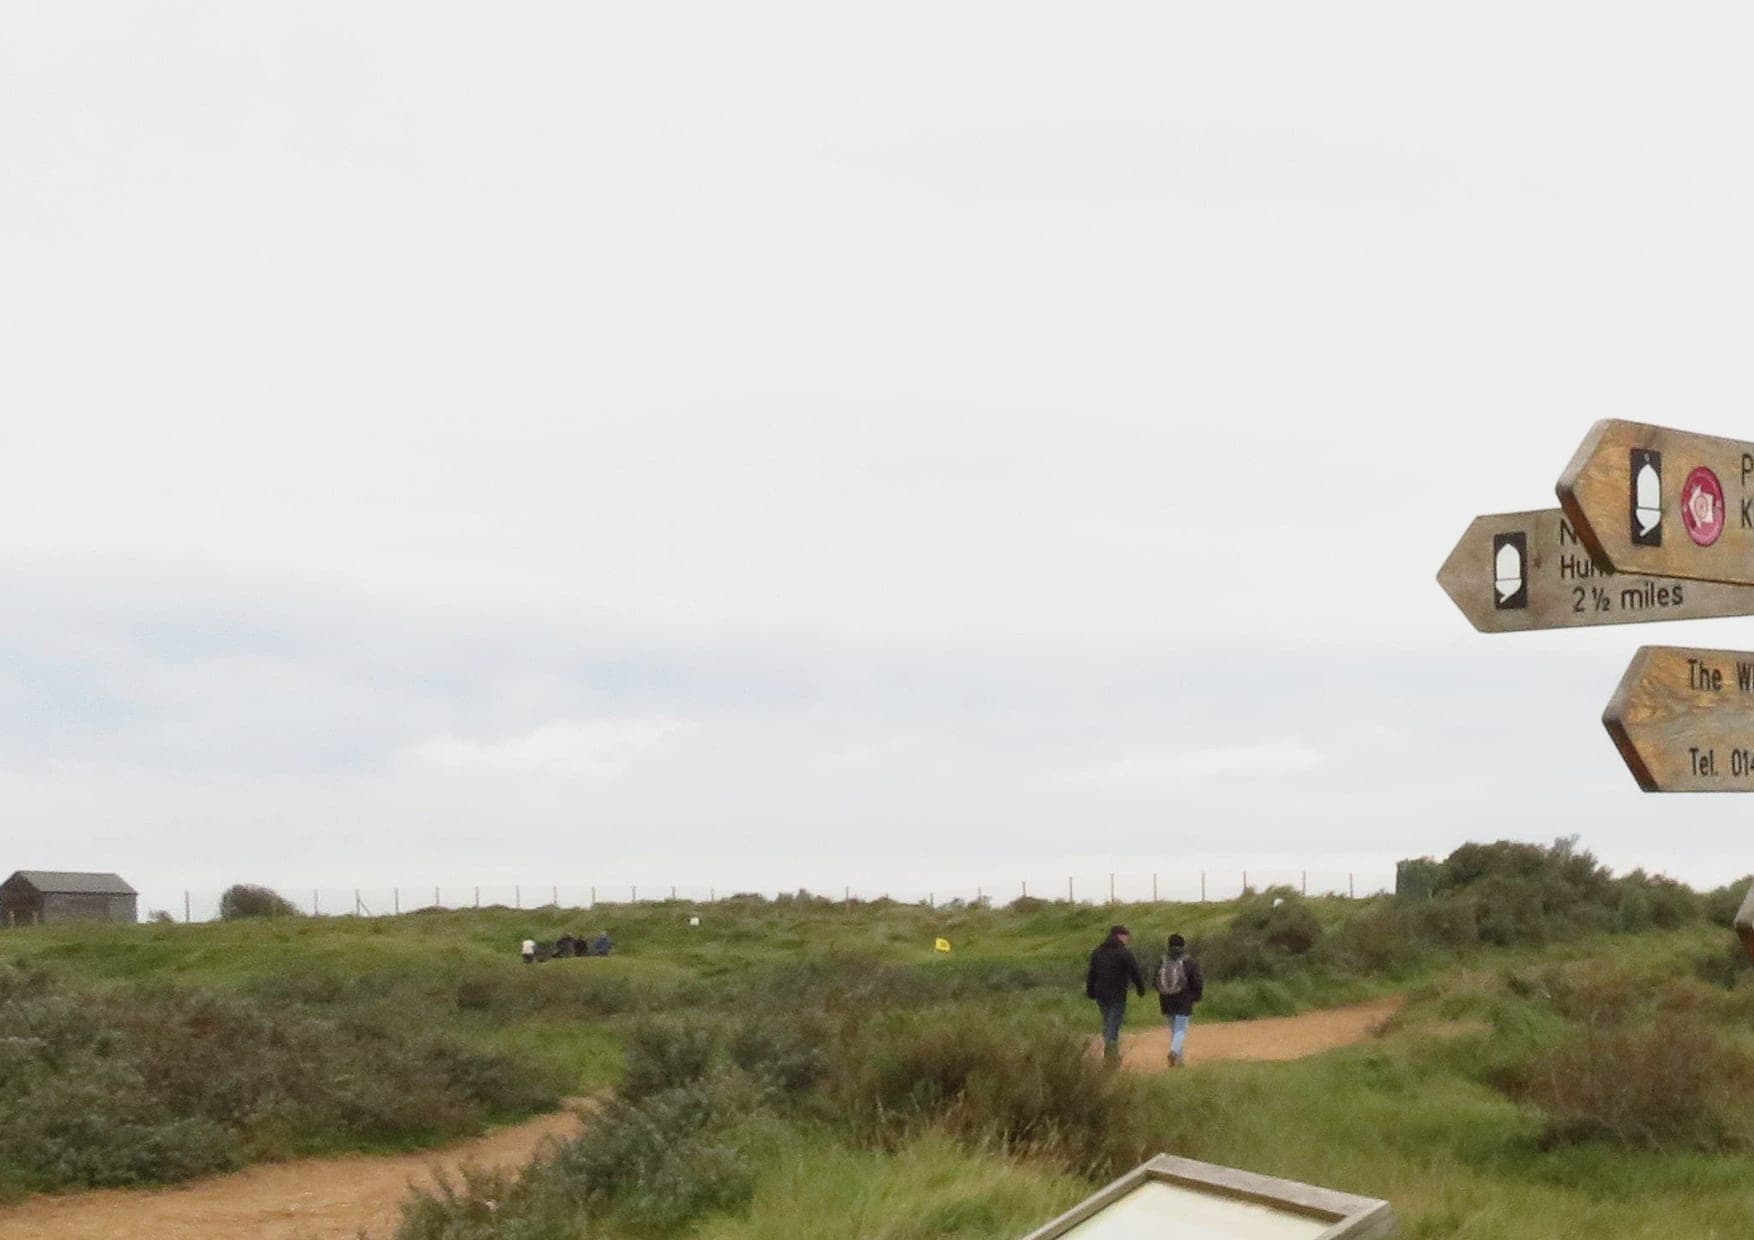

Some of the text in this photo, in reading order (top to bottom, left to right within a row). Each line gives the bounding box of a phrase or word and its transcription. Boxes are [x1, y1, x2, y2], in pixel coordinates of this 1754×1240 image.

[1621, 581, 1684, 610] miles
[1687, 658, 1722, 693] The
[1689, 747, 1719, 777] Tel.
